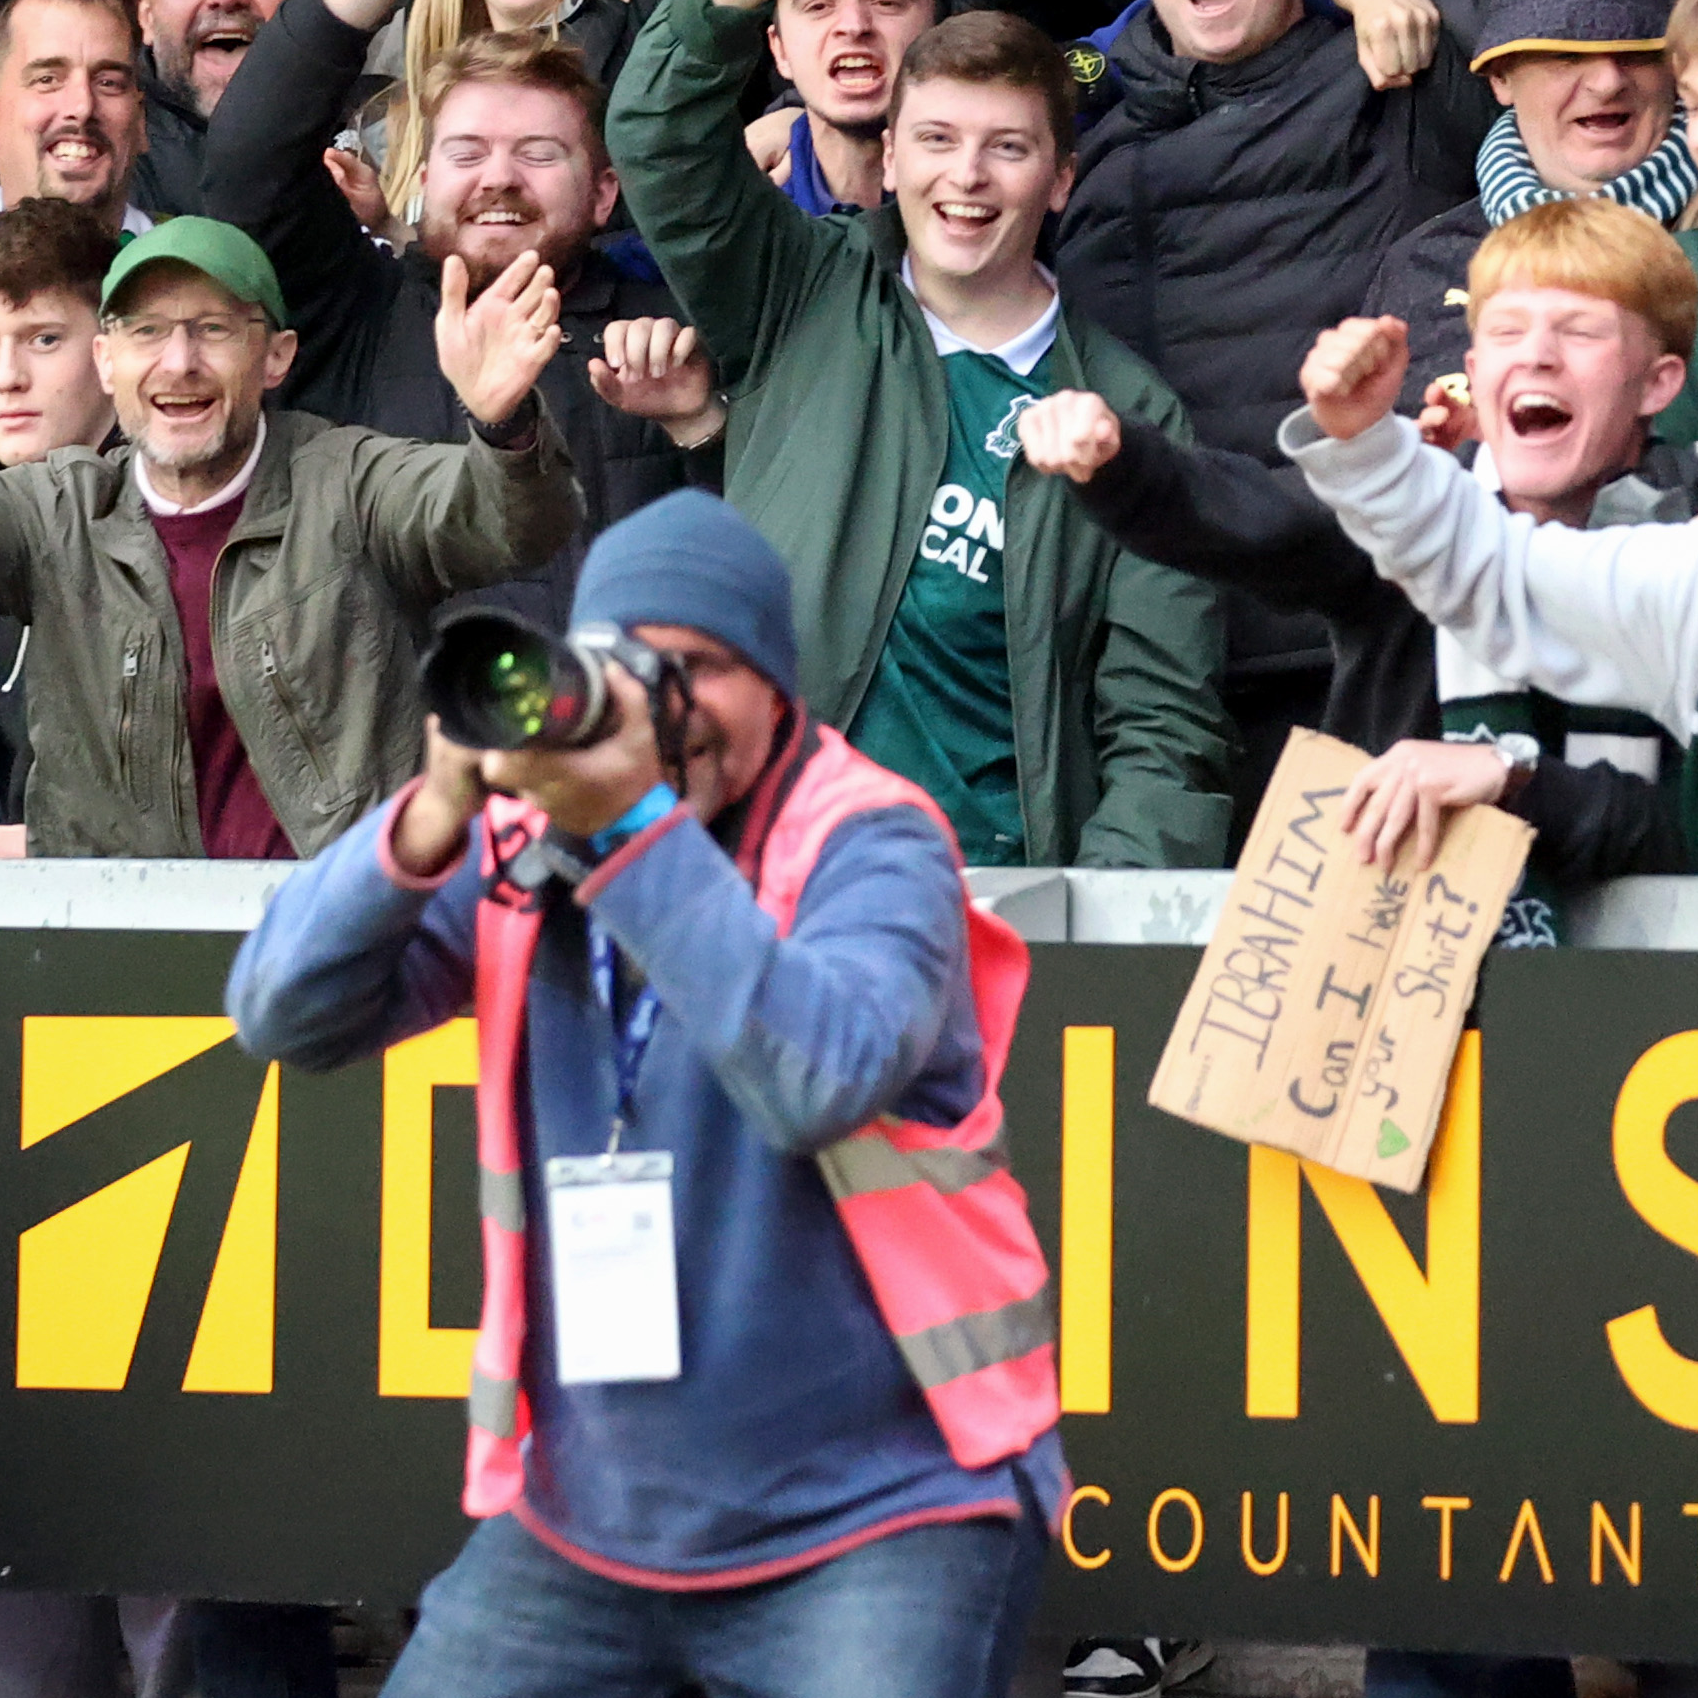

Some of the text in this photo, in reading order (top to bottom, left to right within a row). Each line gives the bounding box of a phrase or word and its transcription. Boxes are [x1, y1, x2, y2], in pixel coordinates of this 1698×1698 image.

[1190, 787, 1348, 1071] IBRAHIM
[1316, 964, 1372, 1020] I
[1287, 1040, 1355, 1119] Can
[1361, 1025, 1398, 1111] your
